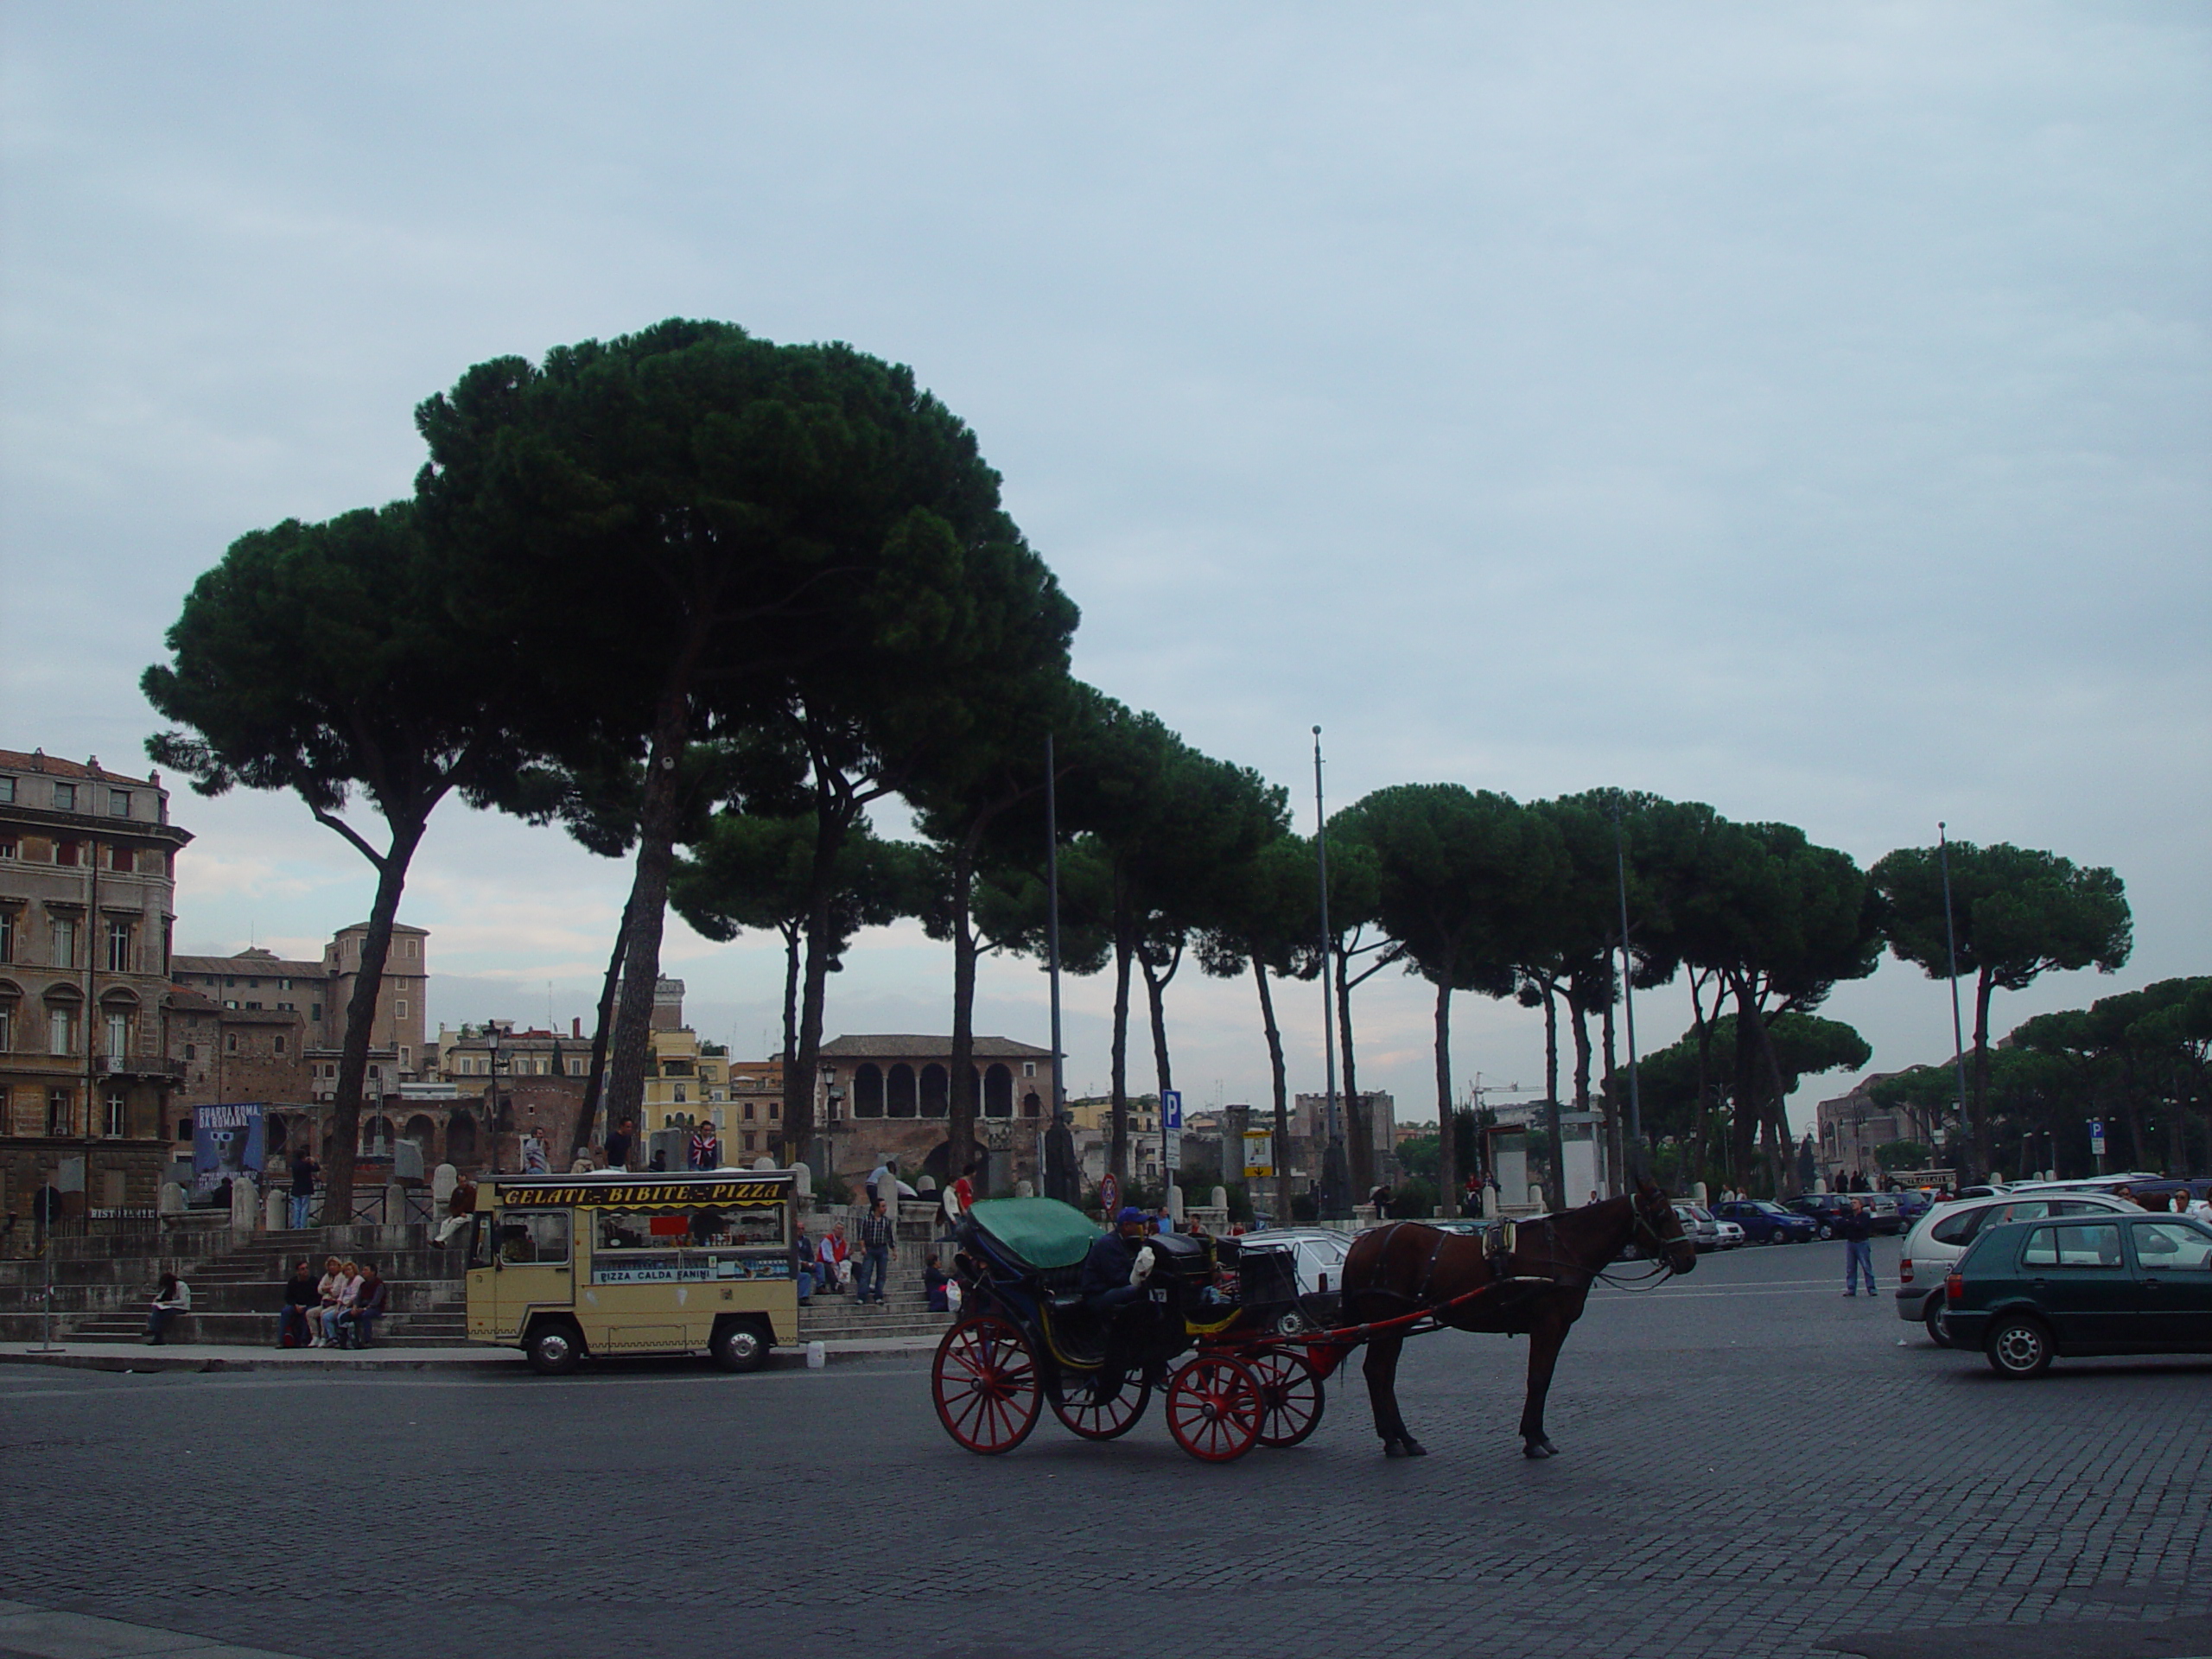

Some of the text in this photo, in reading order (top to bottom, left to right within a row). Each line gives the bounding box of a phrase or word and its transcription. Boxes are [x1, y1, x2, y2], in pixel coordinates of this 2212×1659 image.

[199, 1106, 232, 1116] GUARDA
[1167, 1094, 1178, 1125] P
[199, 1116, 210, 1128] DA
[2093, 1123, 2101, 1136] P
[505, 1184, 780, 1204] GELATI BIBITE PIZZA
[601, 1272, 631, 1281] PIZZA
[638, 1271, 672, 1280] CALDA
